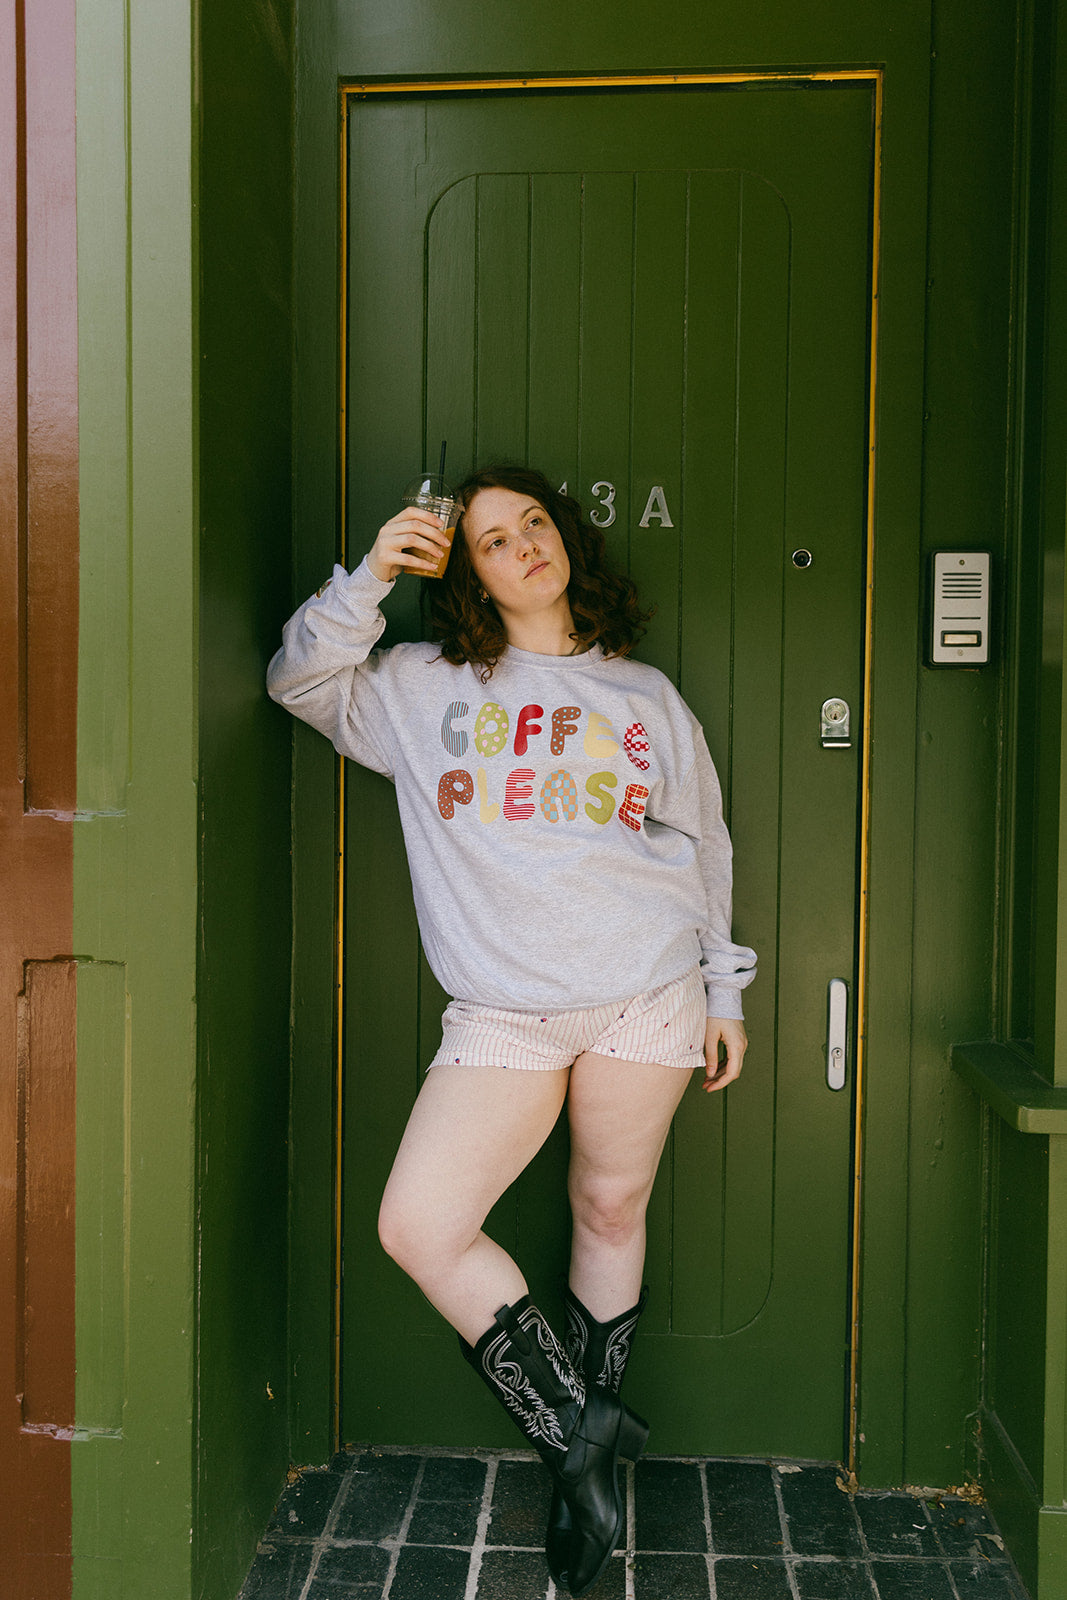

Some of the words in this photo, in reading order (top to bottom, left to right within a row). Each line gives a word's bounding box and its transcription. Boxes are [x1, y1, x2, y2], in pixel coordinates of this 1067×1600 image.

[558, 481, 674, 528] 3A
[441, 701, 650, 770] COFFEE
[437, 767, 649, 832] PLEASE
